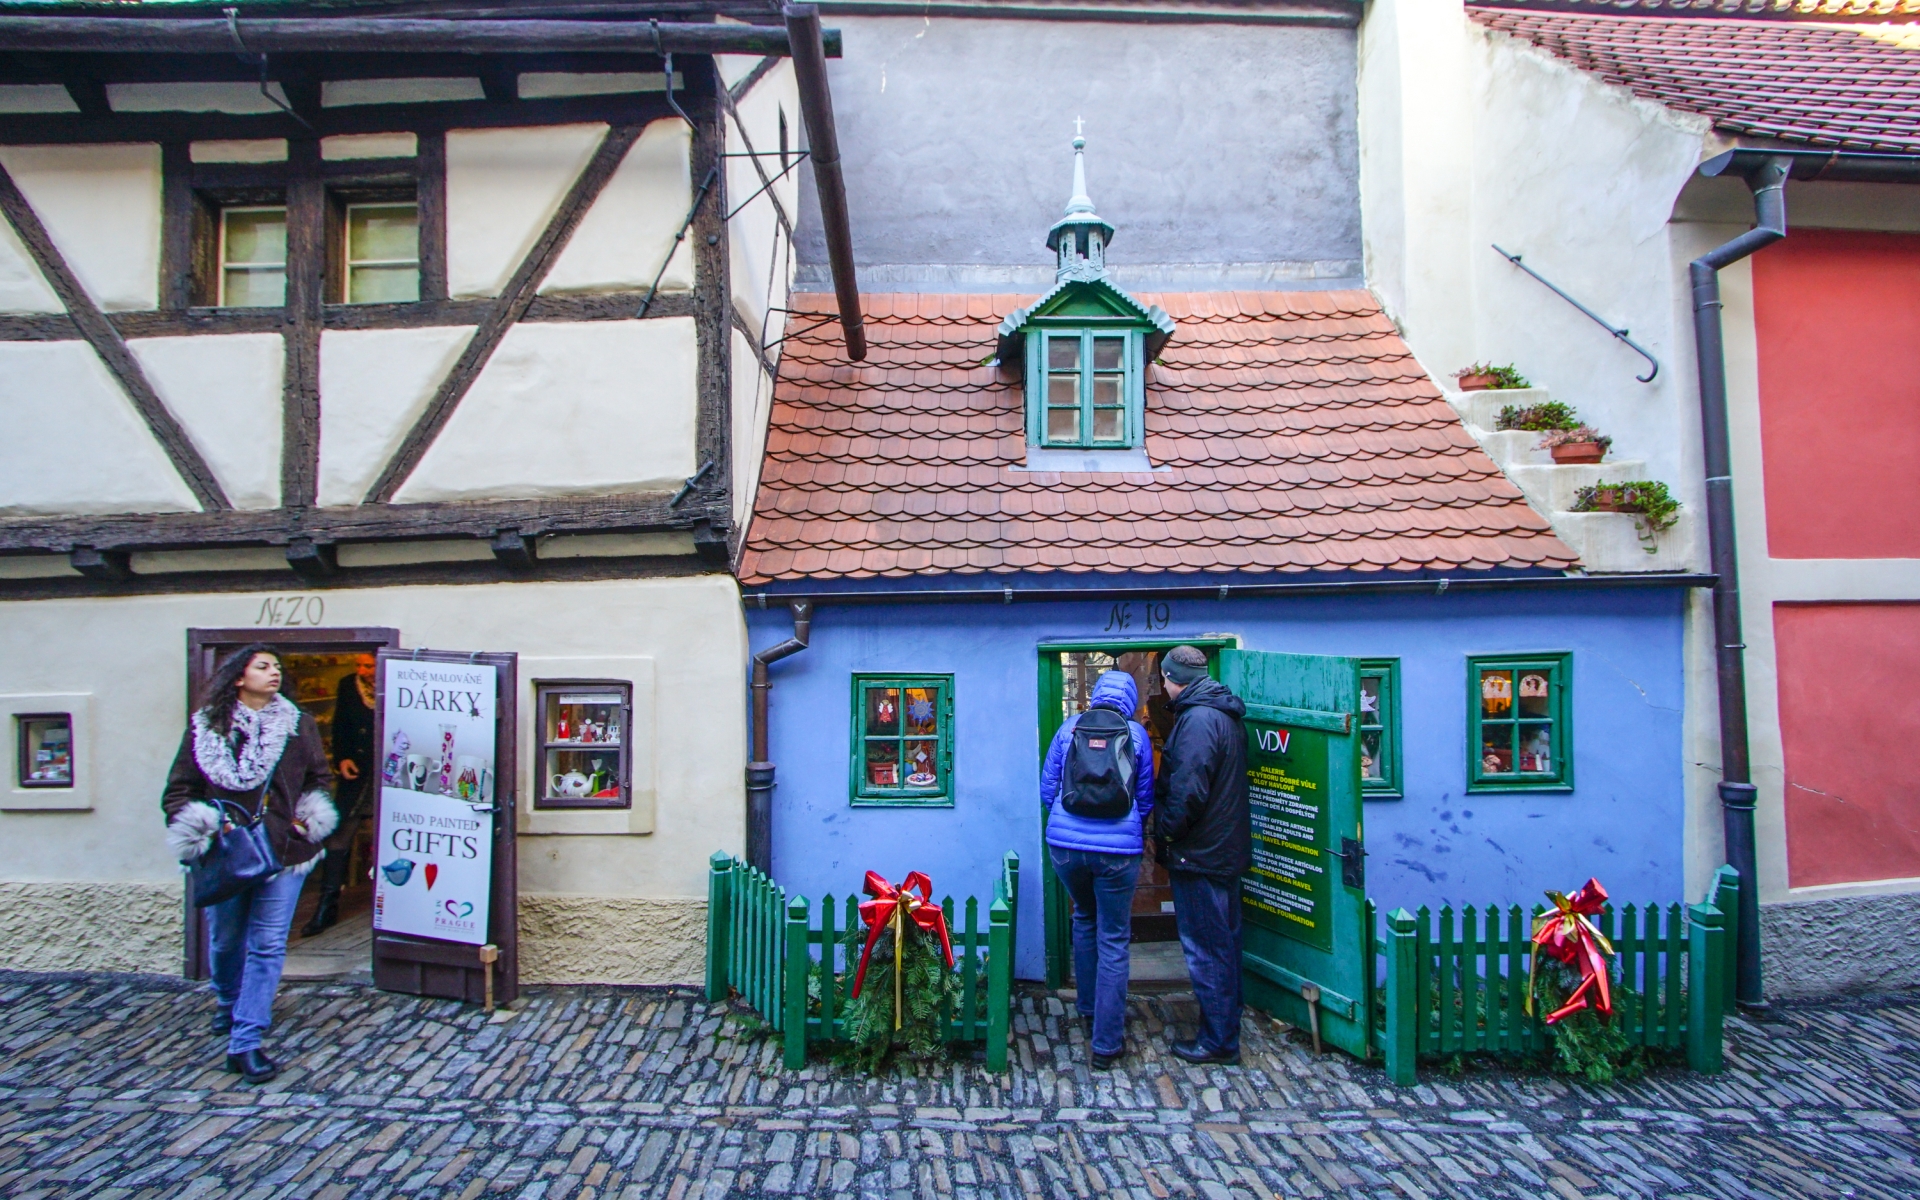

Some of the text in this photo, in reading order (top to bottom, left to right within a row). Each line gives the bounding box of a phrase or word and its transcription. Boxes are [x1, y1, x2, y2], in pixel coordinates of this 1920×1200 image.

[1144, 602, 1170, 632] 19
[397, 683, 482, 714] DÁRKY
[1256, 728, 1290, 754] VDV
[1261, 766, 1285, 776] GALERIE
[1254, 778, 1268, 786] OLGY
[1280, 777, 1300, 786] DOBRÉ
[392, 812, 478, 831] HAND PAINTED
[1270, 818, 1290, 828] OFFERS
[1290, 823, 1314, 834] ARTICLES
[392, 828, 478, 859] GIFTS
[1262, 835, 1280, 846] HAVEL
[1282, 840, 1319, 856] FOUNDATION
[1278, 862, 1306, 875] PERSONAS
[1276, 874, 1292, 884] OLGA
[1292, 880, 1312, 892] HAVEL
[1242, 896, 1314, 928] OLGA HAVEL FOUNDATION
[435, 917, 475, 928] PRAGUE
